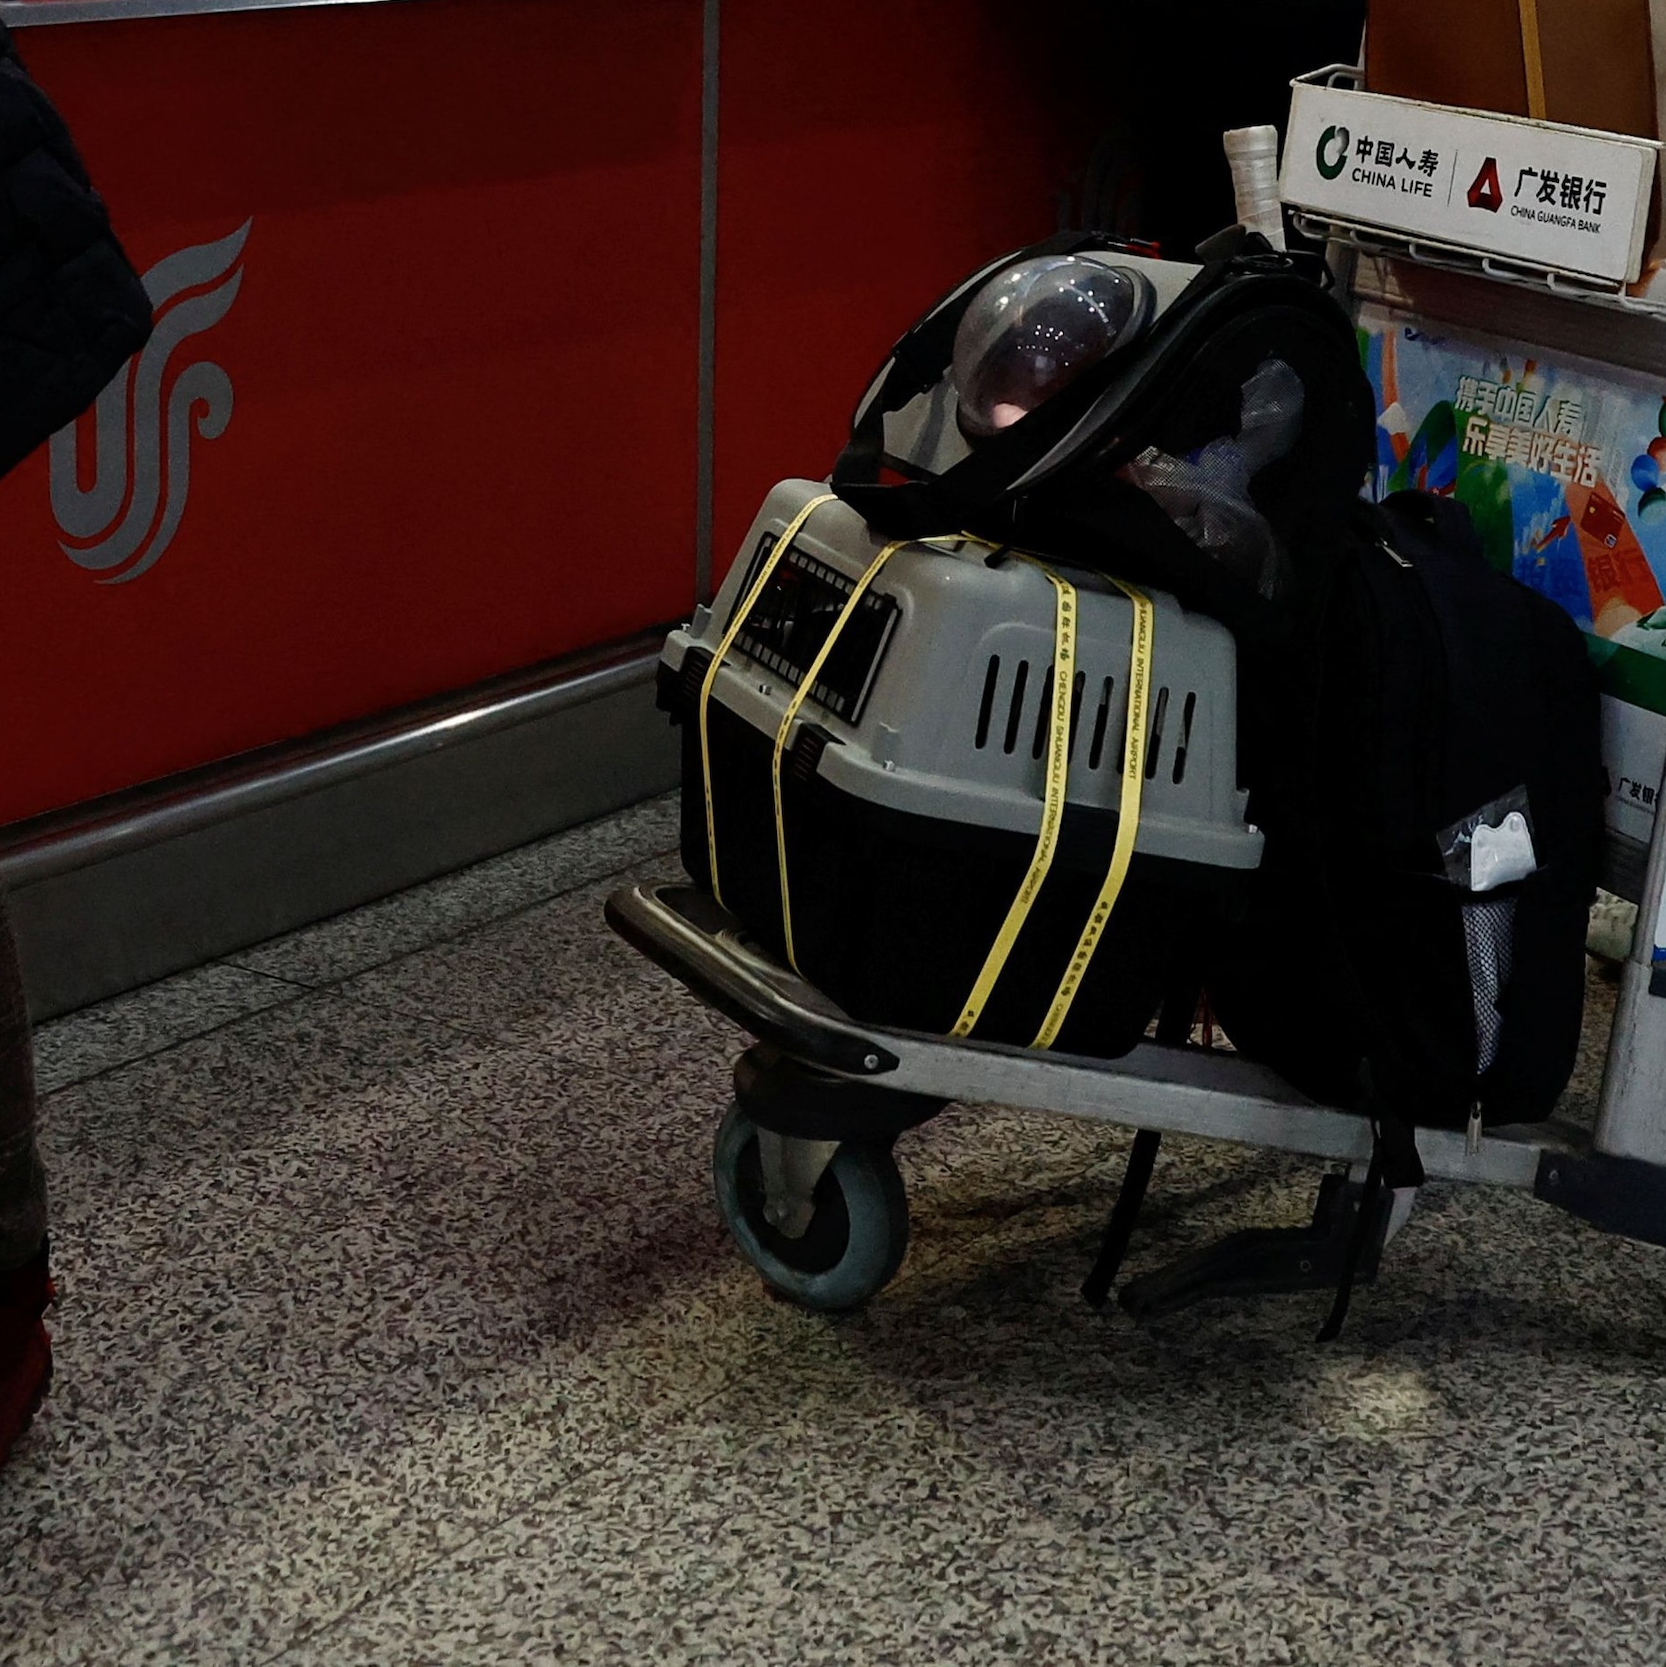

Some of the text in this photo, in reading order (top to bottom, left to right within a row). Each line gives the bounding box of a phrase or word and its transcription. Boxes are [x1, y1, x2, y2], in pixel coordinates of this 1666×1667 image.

[1355, 136, 1439, 178] 中国人寿
[1352, 168, 1433, 198] CHINA LIFE
[1514, 166, 1608, 216] 广发银行
[1510, 205, 1602, 234] CHINA GUANGFA BANK
[1455, 375, 1582, 435] 携手中国人寿
[1462, 416, 1601, 488] 乐享美好生活
[1618, 778, 1658, 806] 广发银
